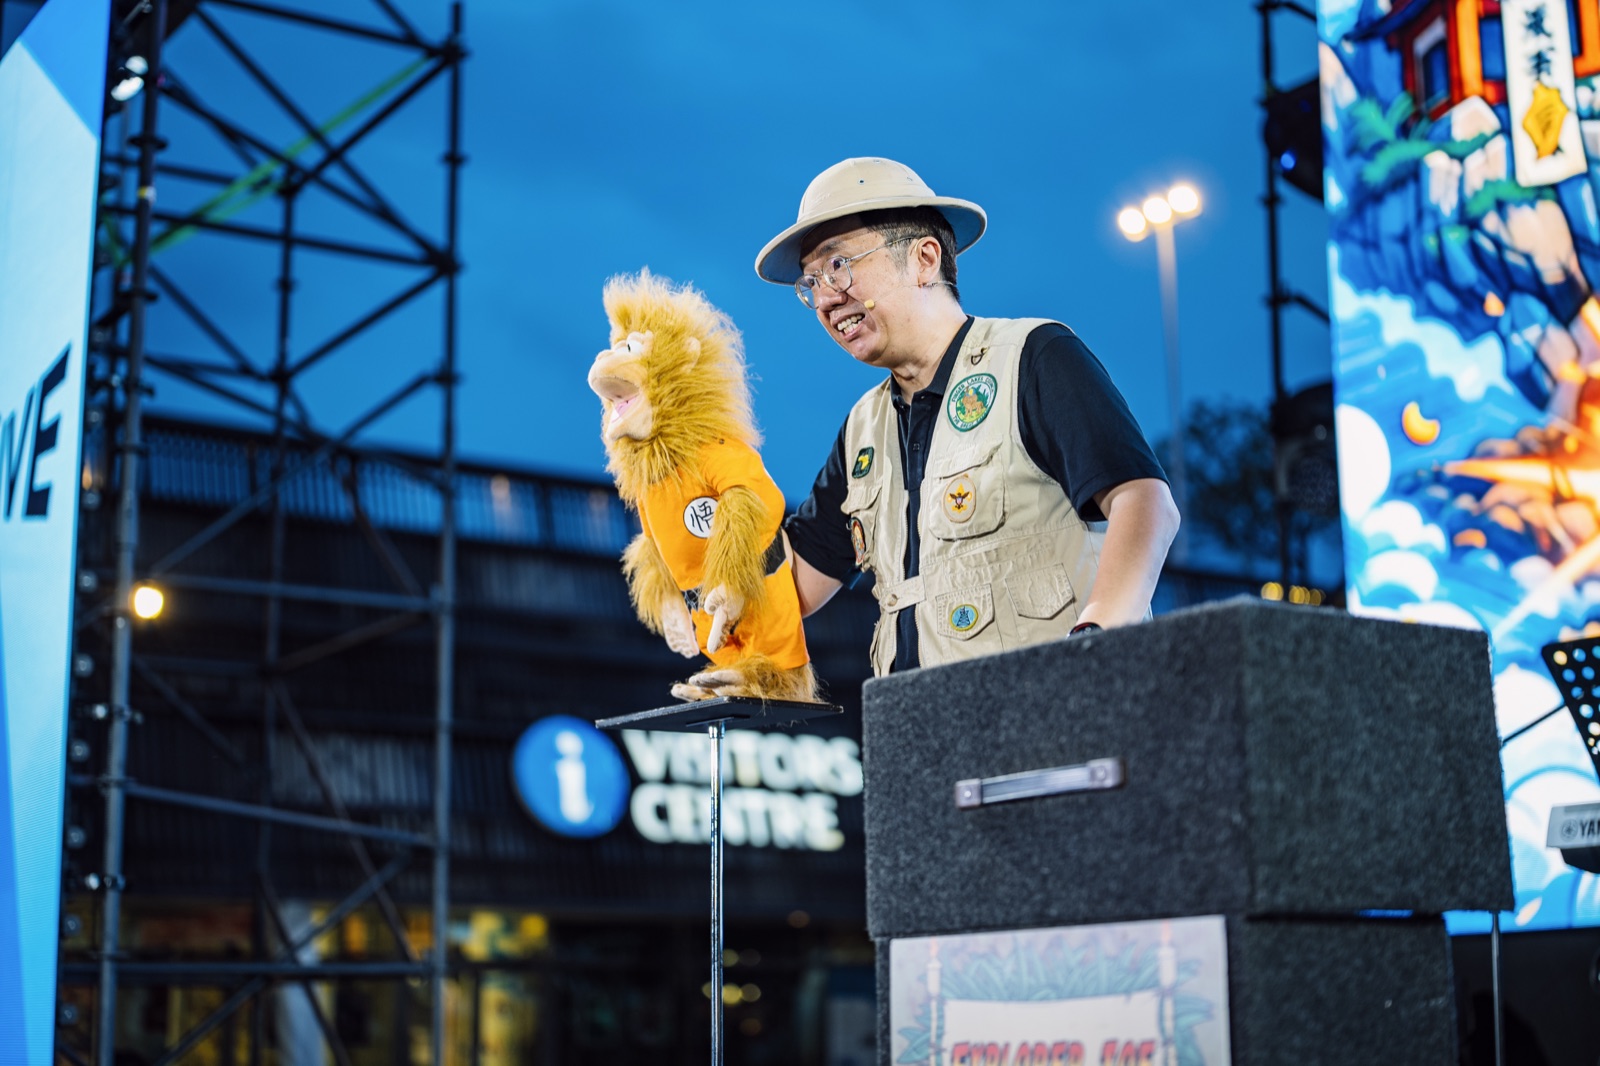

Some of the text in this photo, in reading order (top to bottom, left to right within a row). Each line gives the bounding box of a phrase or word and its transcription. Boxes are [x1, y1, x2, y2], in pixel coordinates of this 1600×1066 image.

[0, 343, 71, 519] VE
[631, 782, 845, 852] CENTRE
[1580, 818, 1600, 839] YA
